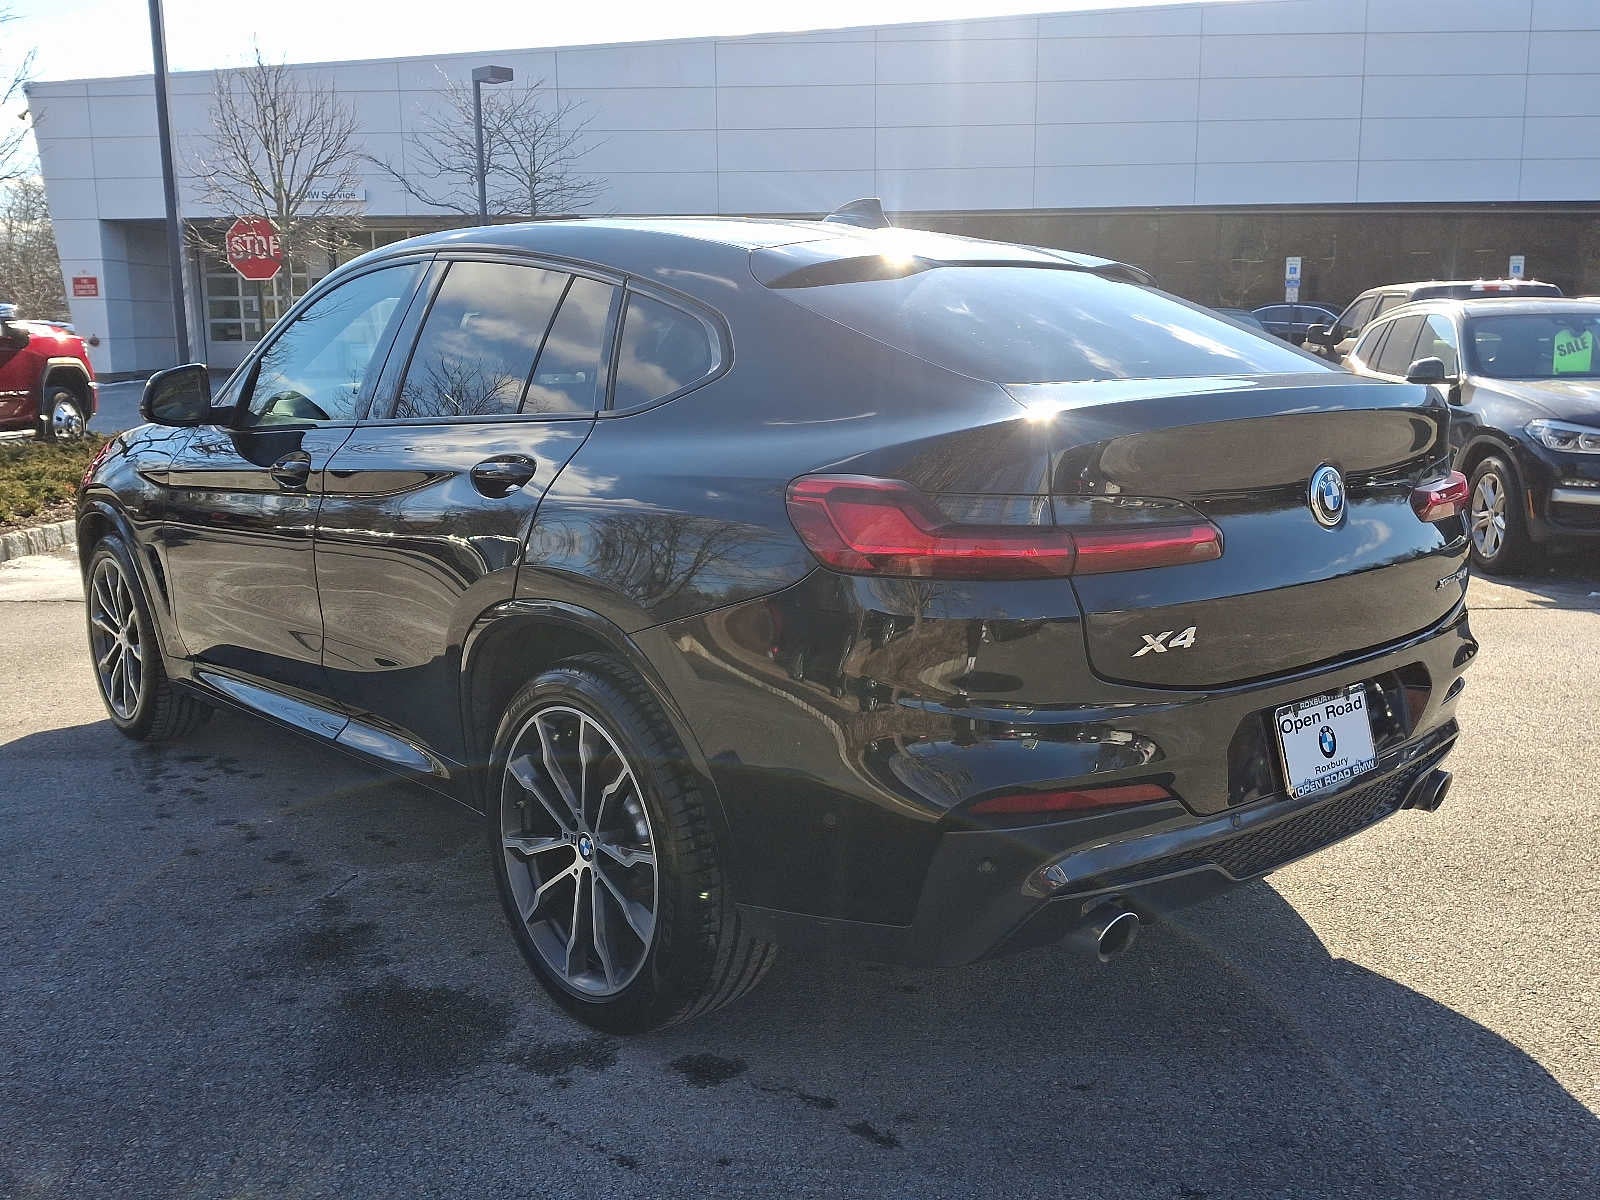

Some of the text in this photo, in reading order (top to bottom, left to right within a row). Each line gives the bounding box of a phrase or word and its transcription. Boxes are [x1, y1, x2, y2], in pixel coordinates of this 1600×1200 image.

[1556, 336, 1589, 357] SALE
[1129, 626, 1197, 658] X4
[1281, 696, 1363, 734] Open Road
[1297, 760, 1376, 797] OPEN ROAD BMW
[1314, 757, 1348, 775] Roxbury
